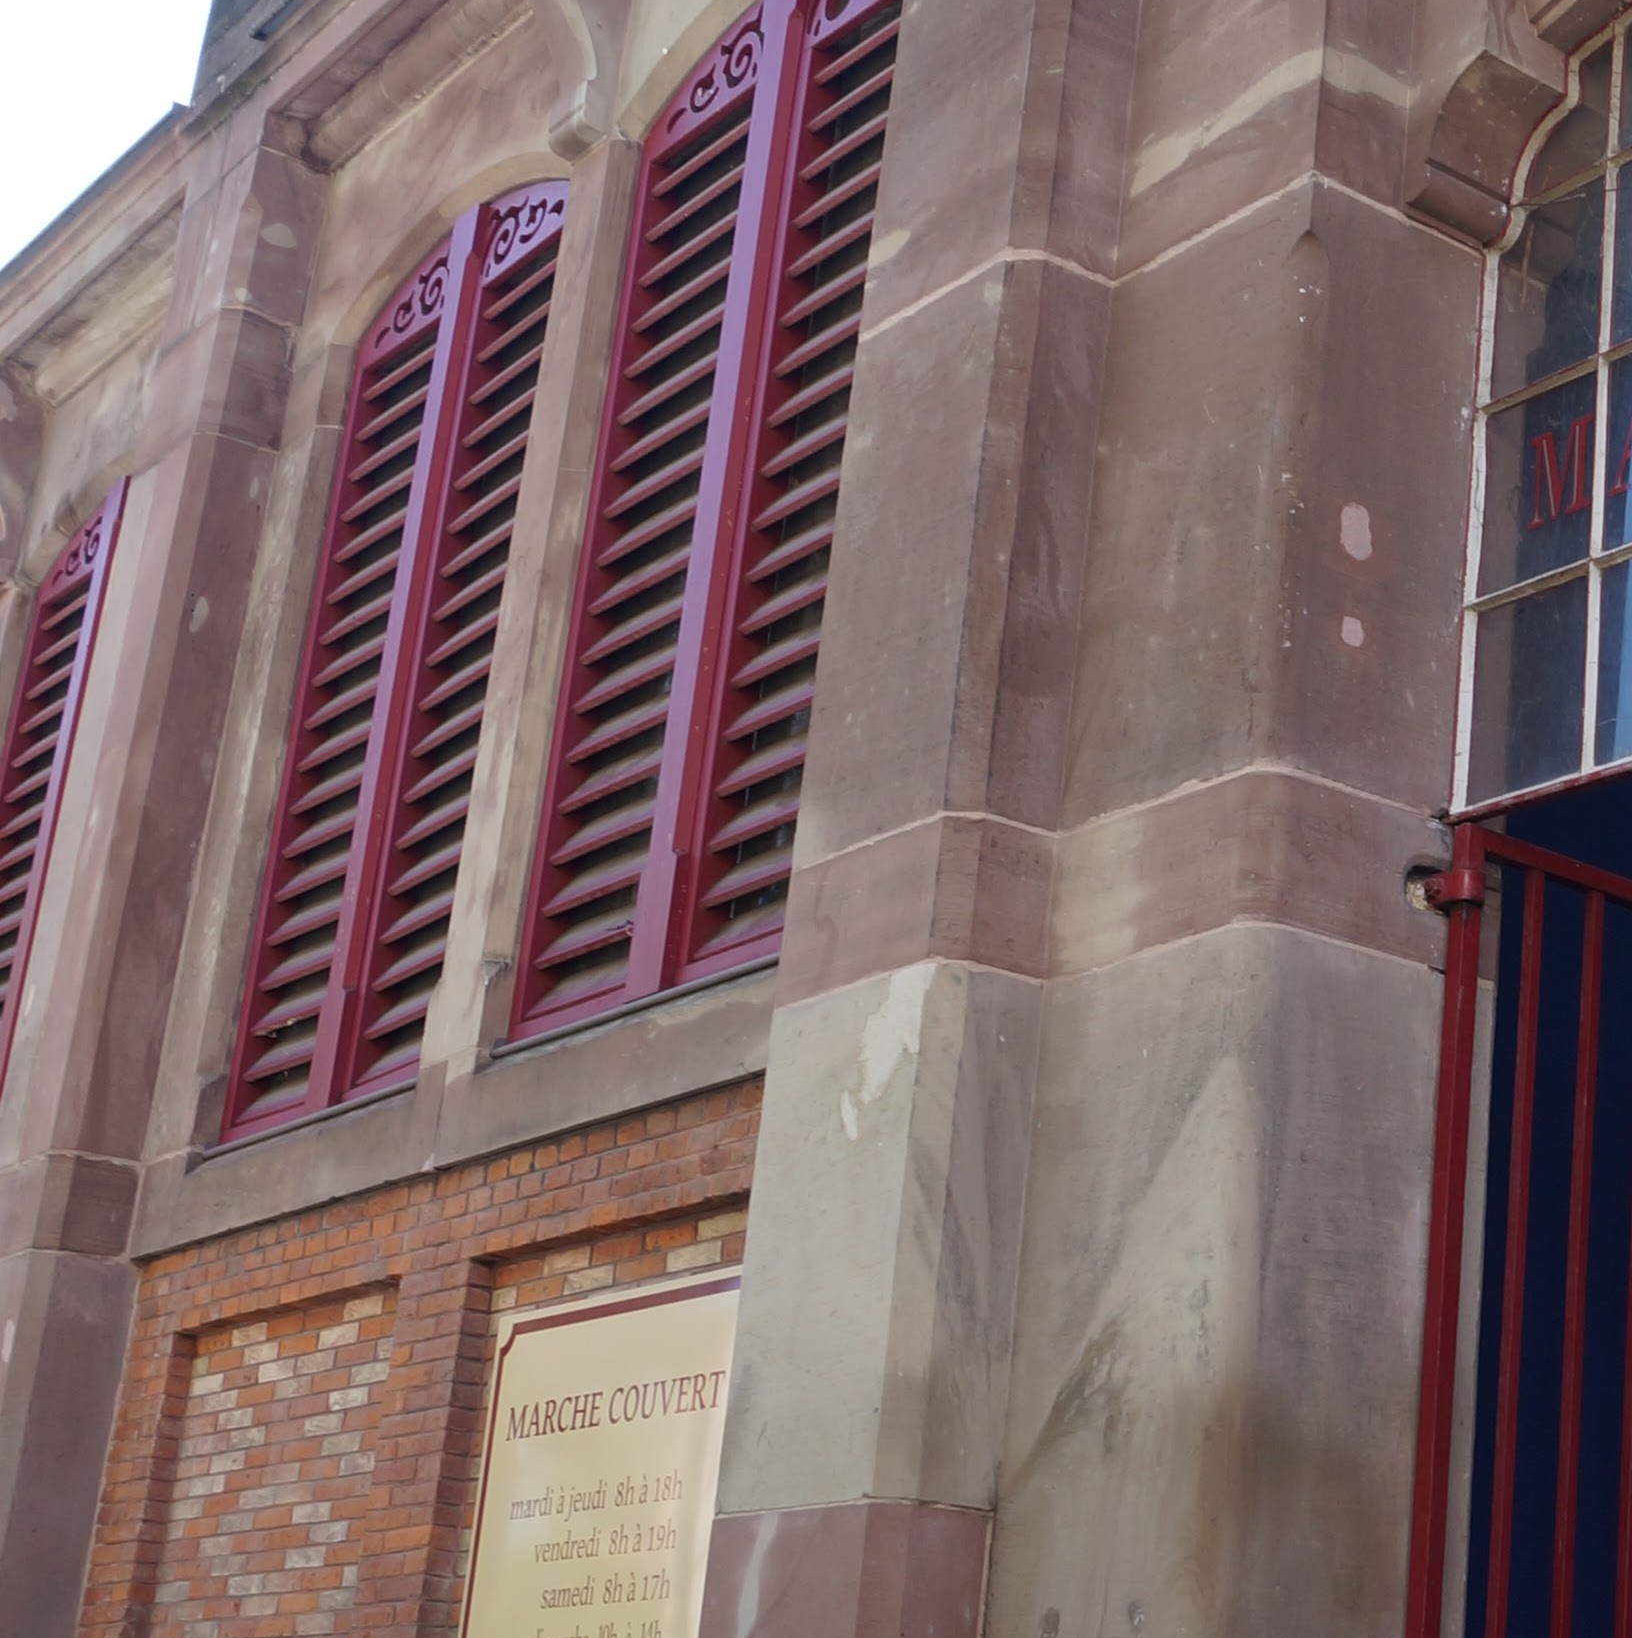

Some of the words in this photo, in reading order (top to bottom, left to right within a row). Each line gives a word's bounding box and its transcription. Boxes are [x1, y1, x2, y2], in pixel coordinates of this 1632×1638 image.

[505, 1392, 603, 1442] MARCHE
[608, 1370, 726, 1425] COUVERT
[509, 1483, 553, 1521] mardi
[556, 1485, 566, 1515] à
[565, 1482, 607, 1523] jeudi
[614, 1475, 635, 1507] 8h
[639, 1475, 648, 1504] à
[653, 1470, 683, 1503] 18h
[533, 1529, 601, 1564] vendredi
[608, 1524, 629, 1557] 8h
[633, 1523, 642, 1553] à
[648, 1519, 677, 1552] 19h
[540, 1577, 594, 1611] samedi
[602, 1573, 623, 1605] 8h
[626, 1571, 636, 1602] à
[640, 1568, 670, 1602] 17h
